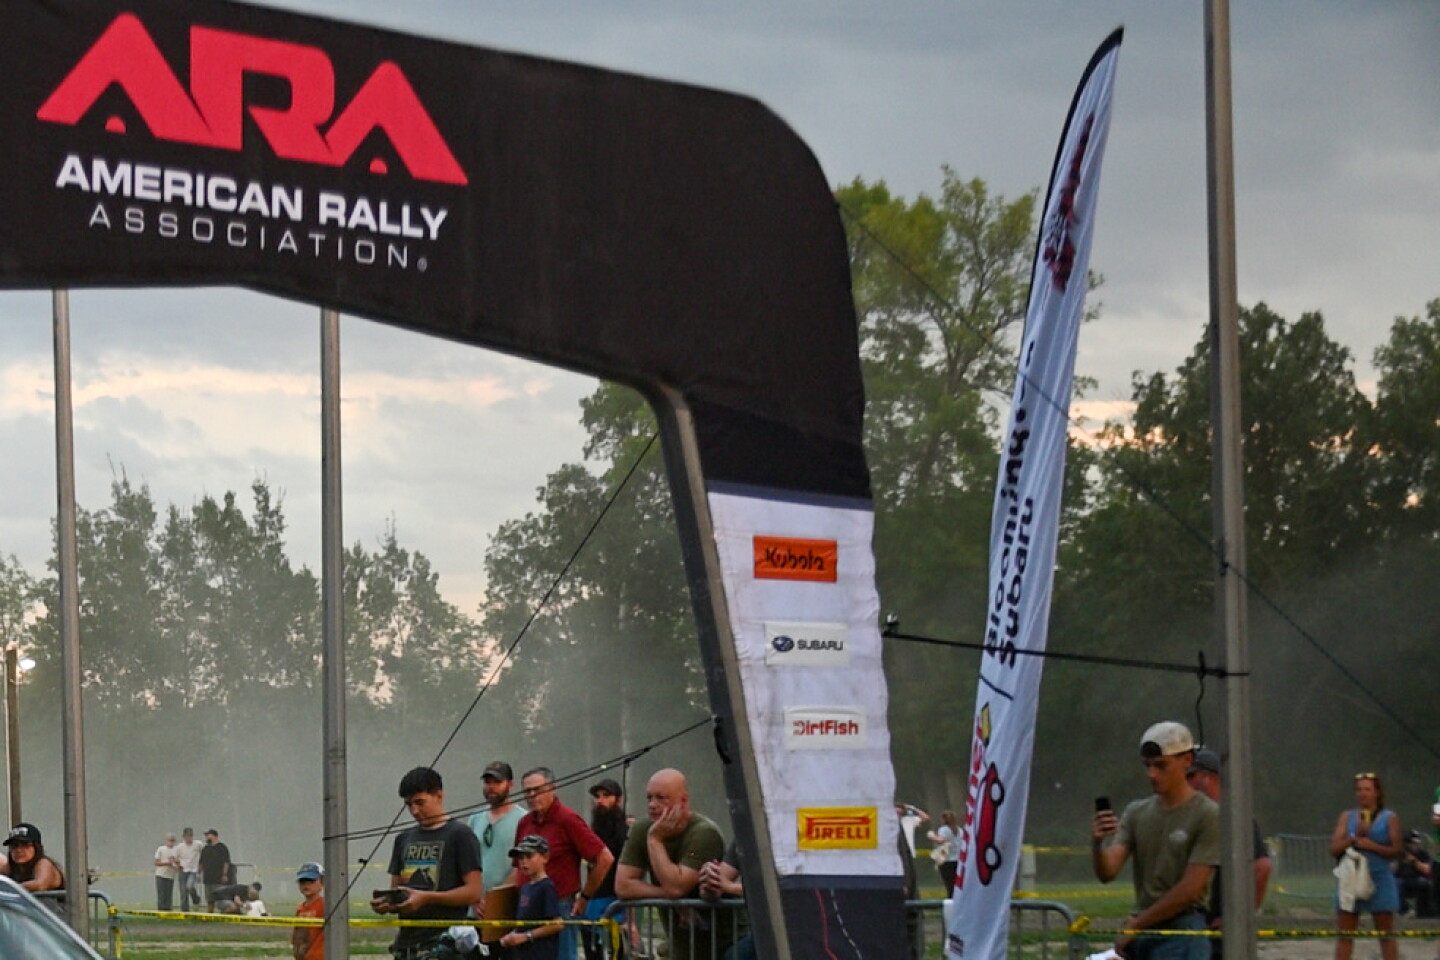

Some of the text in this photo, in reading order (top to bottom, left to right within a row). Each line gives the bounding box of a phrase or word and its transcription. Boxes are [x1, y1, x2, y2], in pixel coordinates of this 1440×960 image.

[36, 11, 469, 187] ARA
[56, 154, 448, 241] AMERICAN RALLY
[766, 547, 825, 571] Kubota
[999, 497, 1034, 669] Subaru
[797, 639, 844, 652] SUBARU
[792, 720, 859, 736] DirtFish
[806, 816, 871, 840] PIRELLI
[408, 845, 440, 860] RIDE
